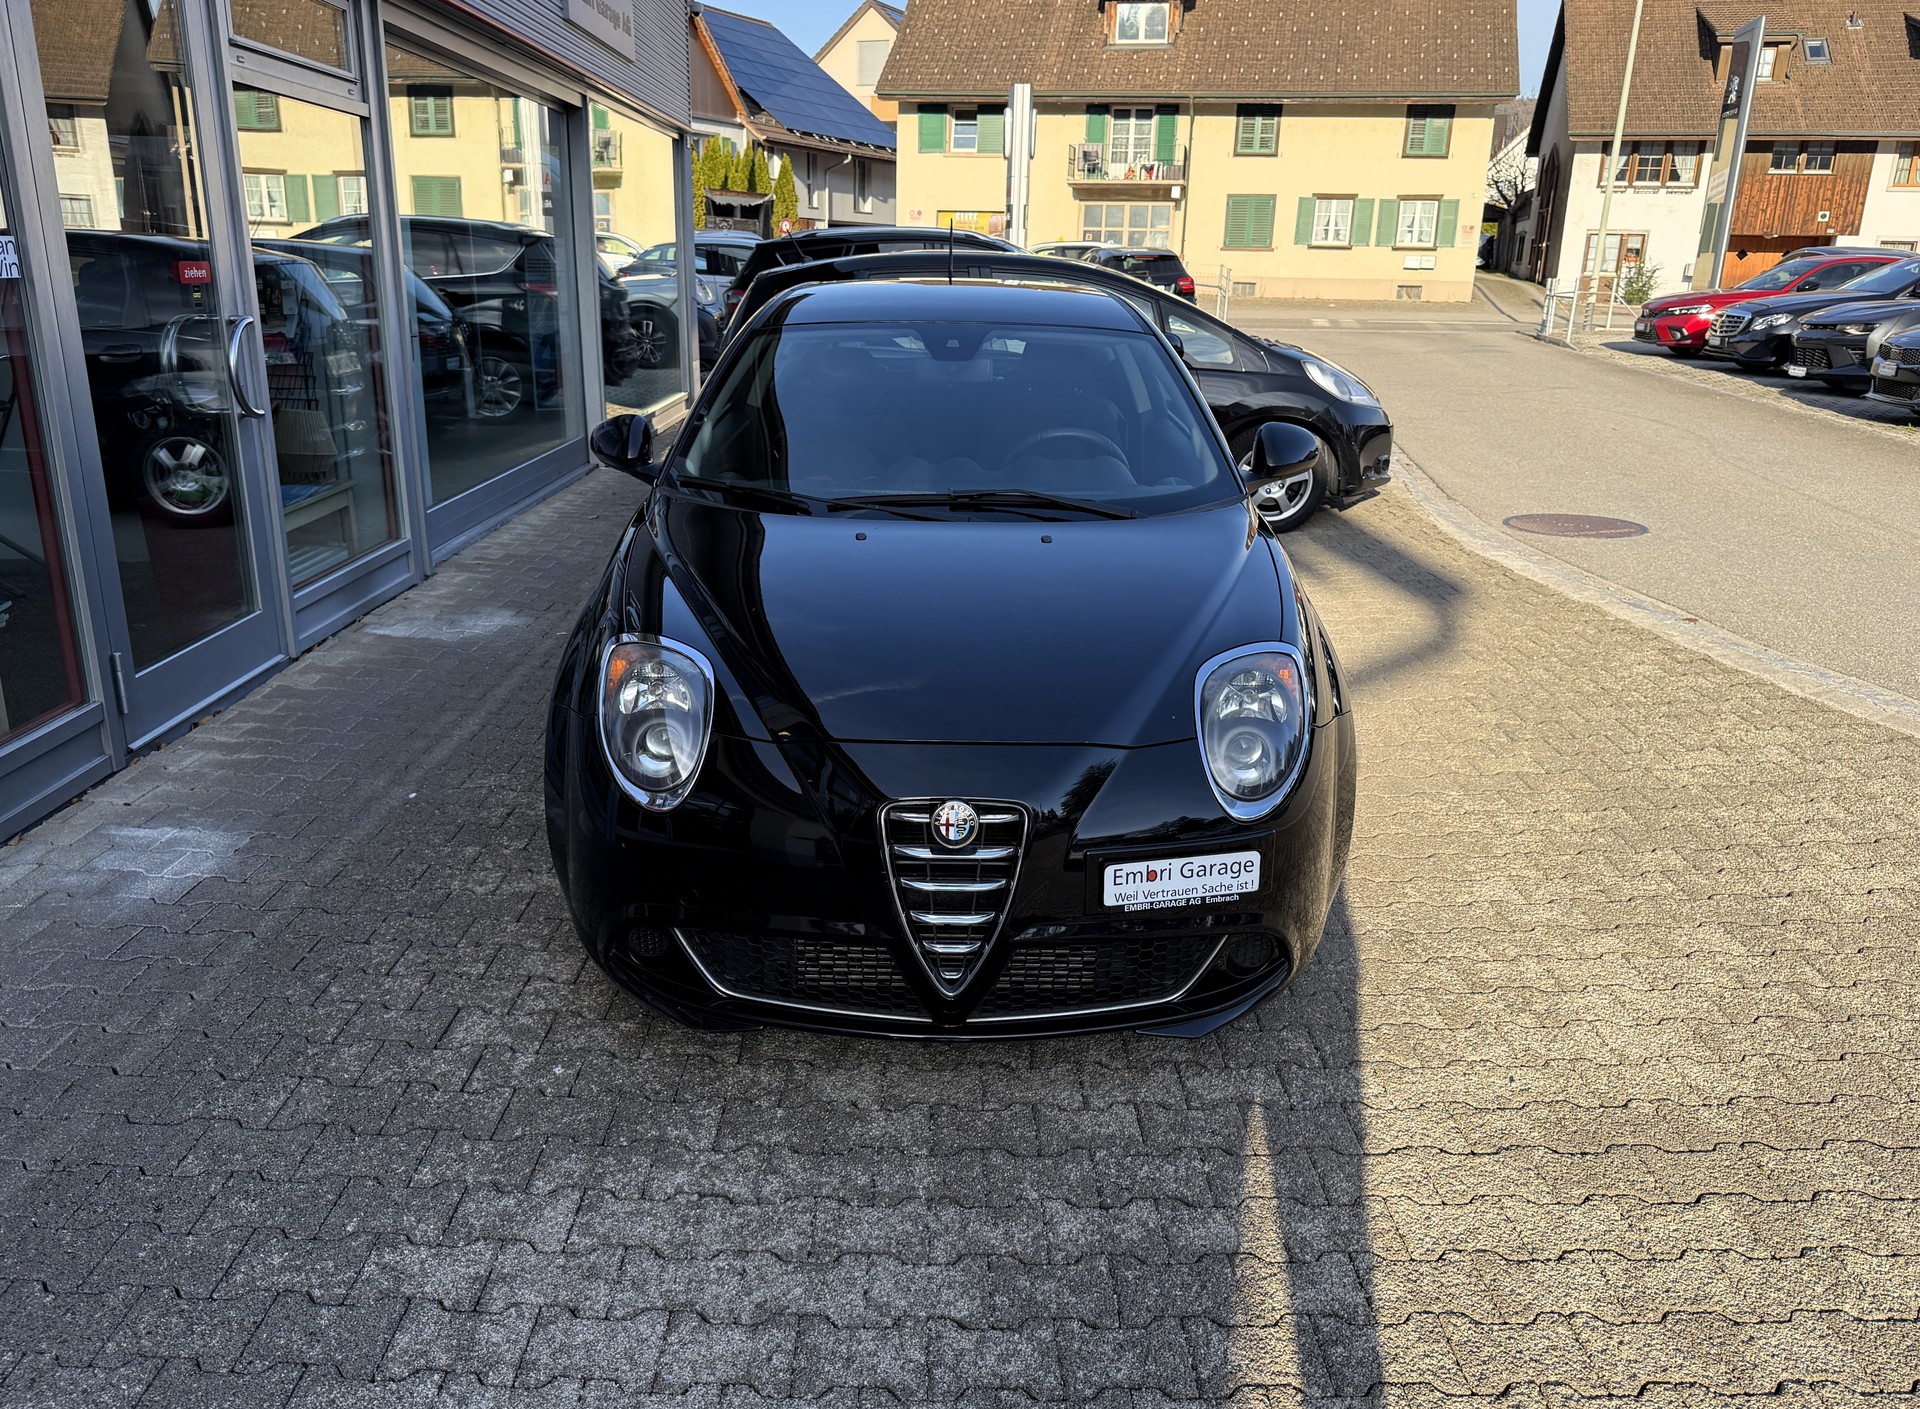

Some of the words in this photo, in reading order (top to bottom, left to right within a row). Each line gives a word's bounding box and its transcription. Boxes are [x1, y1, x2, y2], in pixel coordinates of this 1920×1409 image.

[184, 266, 207, 278] ziehen
[1113, 863, 1172, 886] Embri
[1180, 859, 1255, 879] Garage
[1114, 891, 1139, 903] Weil
[1142, 887, 1198, 900] Vertrauen
[1201, 882, 1234, 894] Sache
[1124, 898, 1187, 912] EMBRI-GARAGE
[1189, 897, 1201, 906] AG
[1205, 894, 1239, 904] Embrach
